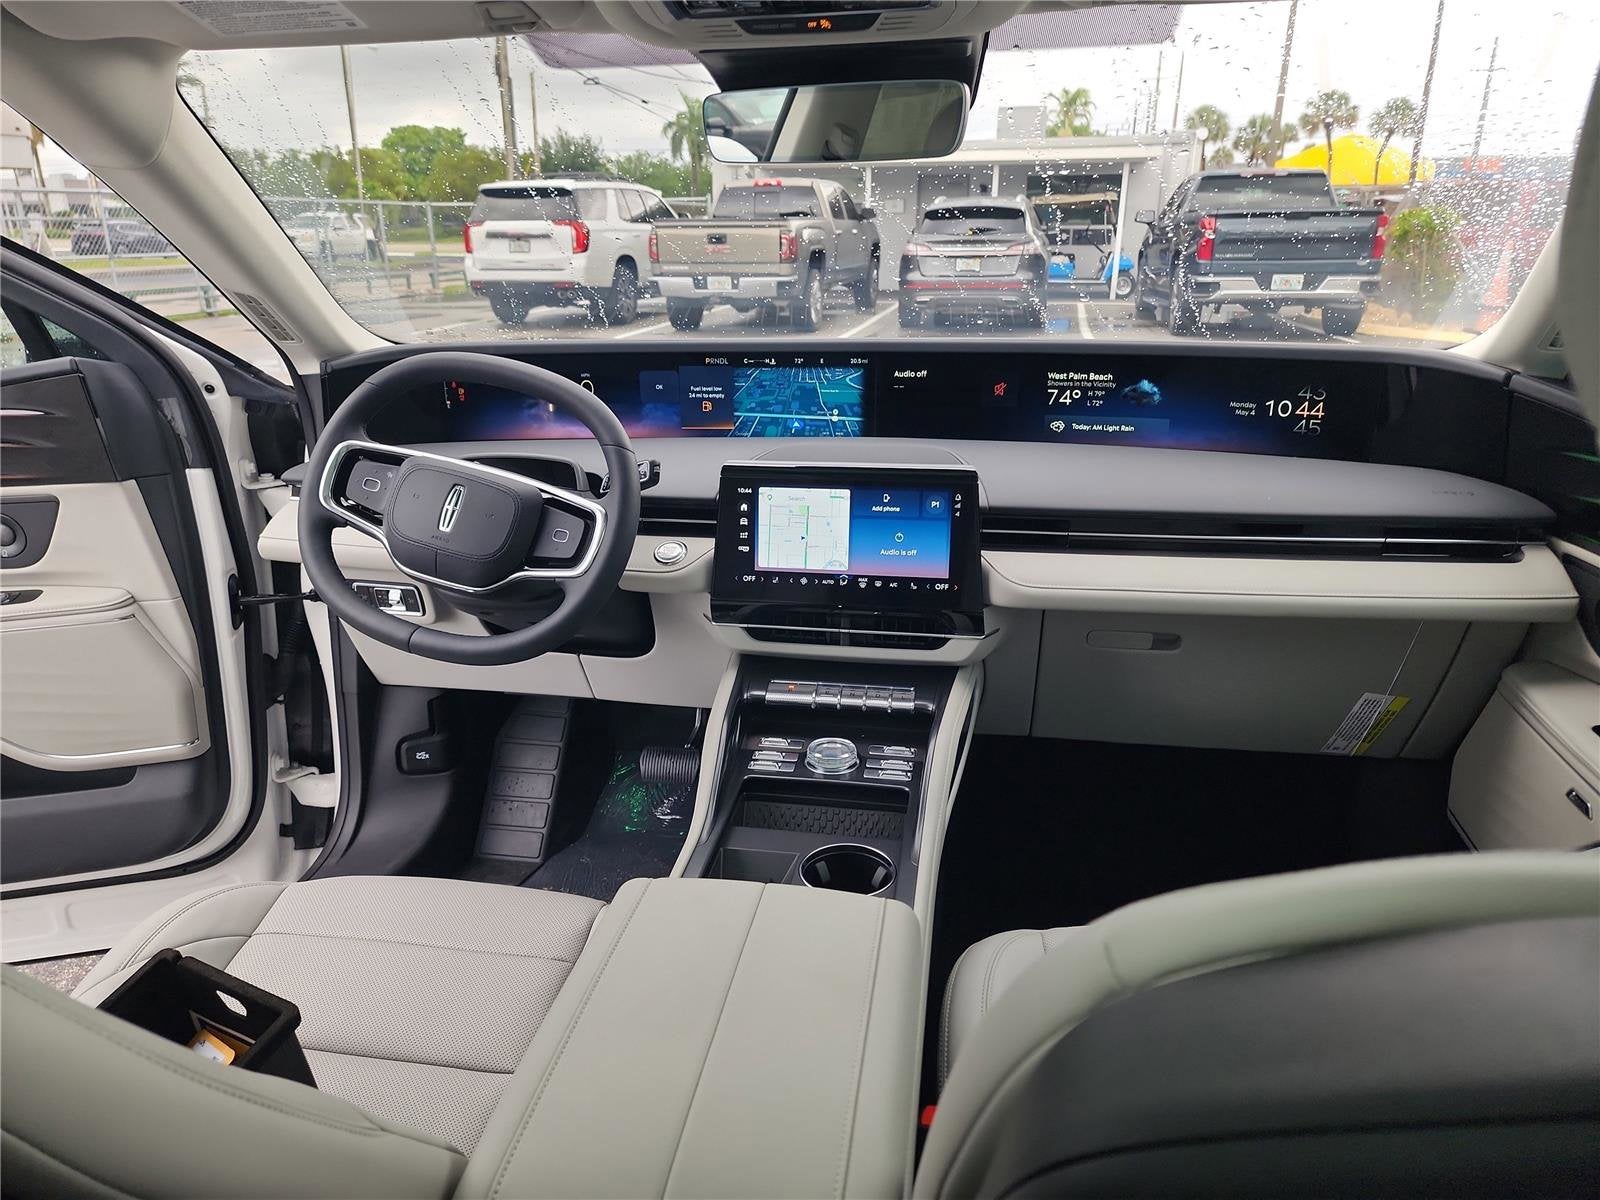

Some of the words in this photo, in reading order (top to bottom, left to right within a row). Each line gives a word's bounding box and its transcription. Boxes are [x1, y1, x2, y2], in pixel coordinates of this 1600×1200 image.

[893, 369, 915, 378] Audio
[916, 369, 928, 378] off
[1047, 372, 1067, 380] West
[1069, 372, 1088, 380] Palm
[1089, 372, 1113, 381] Beach
[1093, 381, 1116, 389] Vicinity
[1297, 385, 1326, 400] 43
[1047, 389, 1081, 406] 74°
[1229, 401, 1257, 409] Monday
[1265, 399, 1292, 417] 10
[1294, 400, 1325, 418] 44
[1072, 423, 1091, 431] Today:
[1292, 419, 1321, 436] 45
[934, 583, 949, 591] OFF
